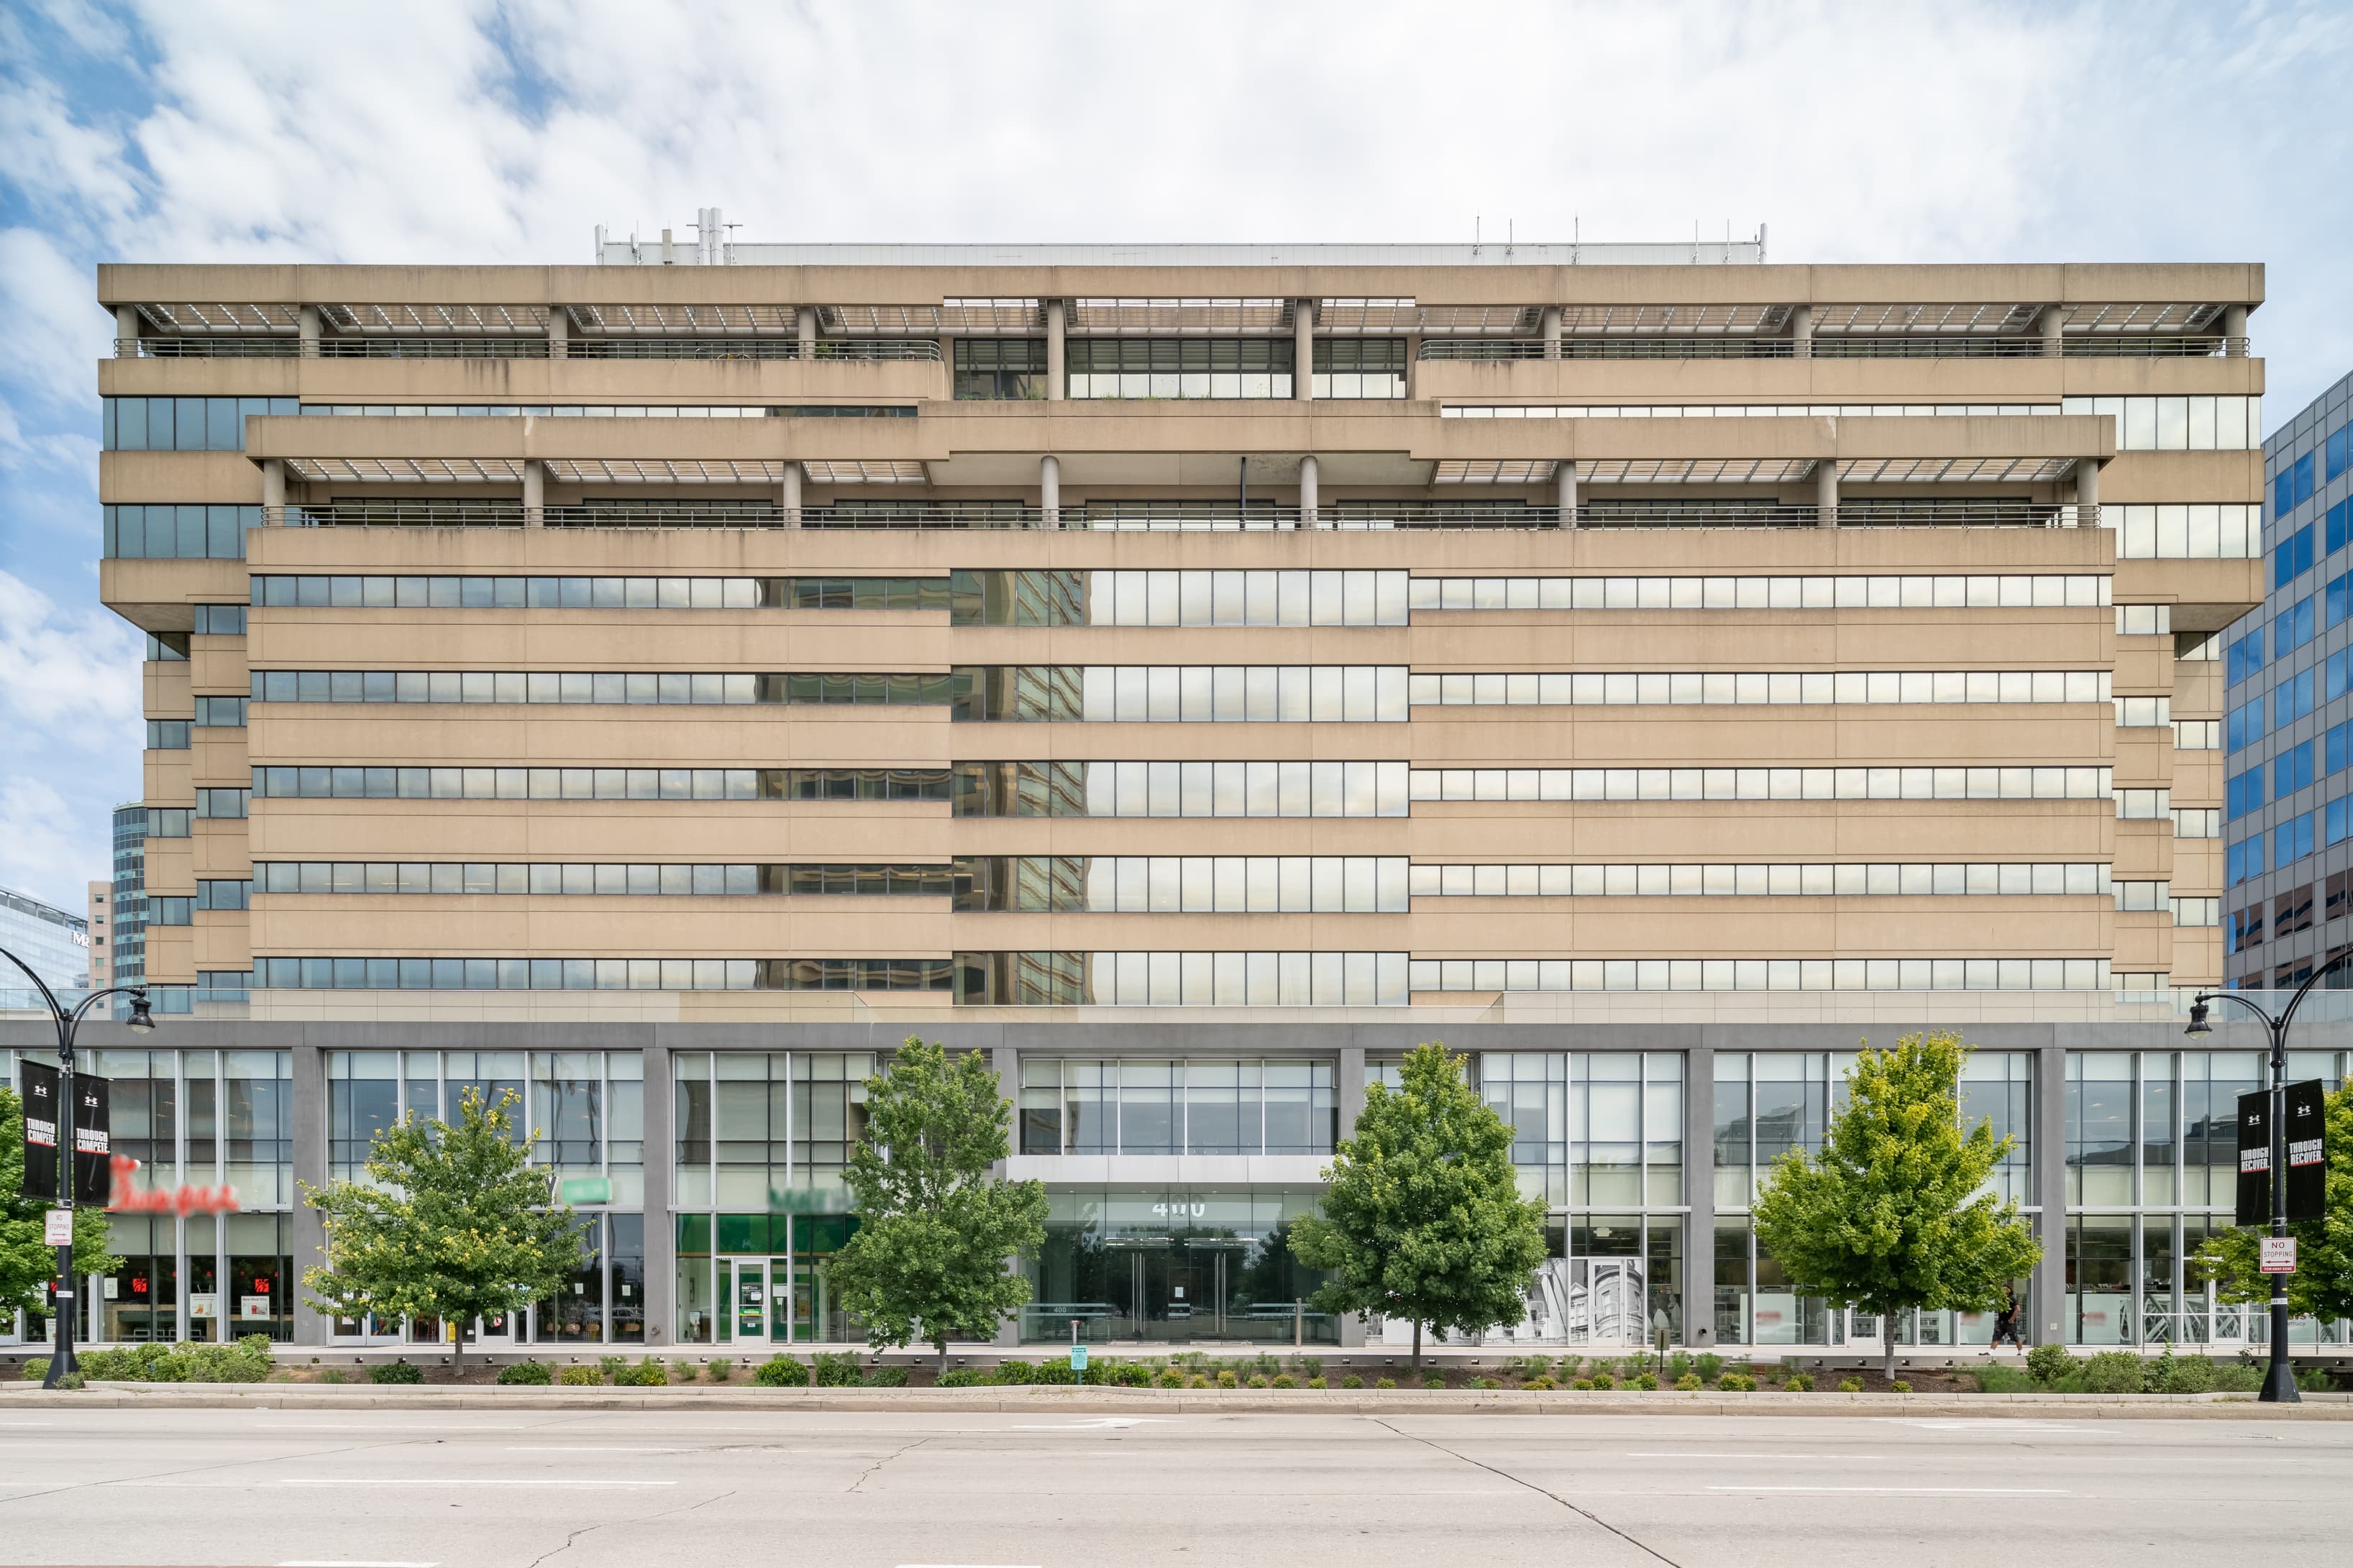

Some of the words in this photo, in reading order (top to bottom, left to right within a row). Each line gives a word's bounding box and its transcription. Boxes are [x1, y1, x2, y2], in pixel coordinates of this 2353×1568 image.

[27, 1117, 55, 1134] THROUGH
[27, 1129, 58, 1146] COMPETE.
[76, 1127, 108, 1142] THROUGH
[76, 1139, 111, 1154] COMPETE.
[2289, 1138, 2322, 1154] THROUGH
[2240, 1147, 2269, 1161] THROUGH
[2290, 1150, 2324, 1165] RECOVER.
[2241, 1157, 2270, 1171] RECOVER.
[1152, 1194, 1205, 1217] 400
